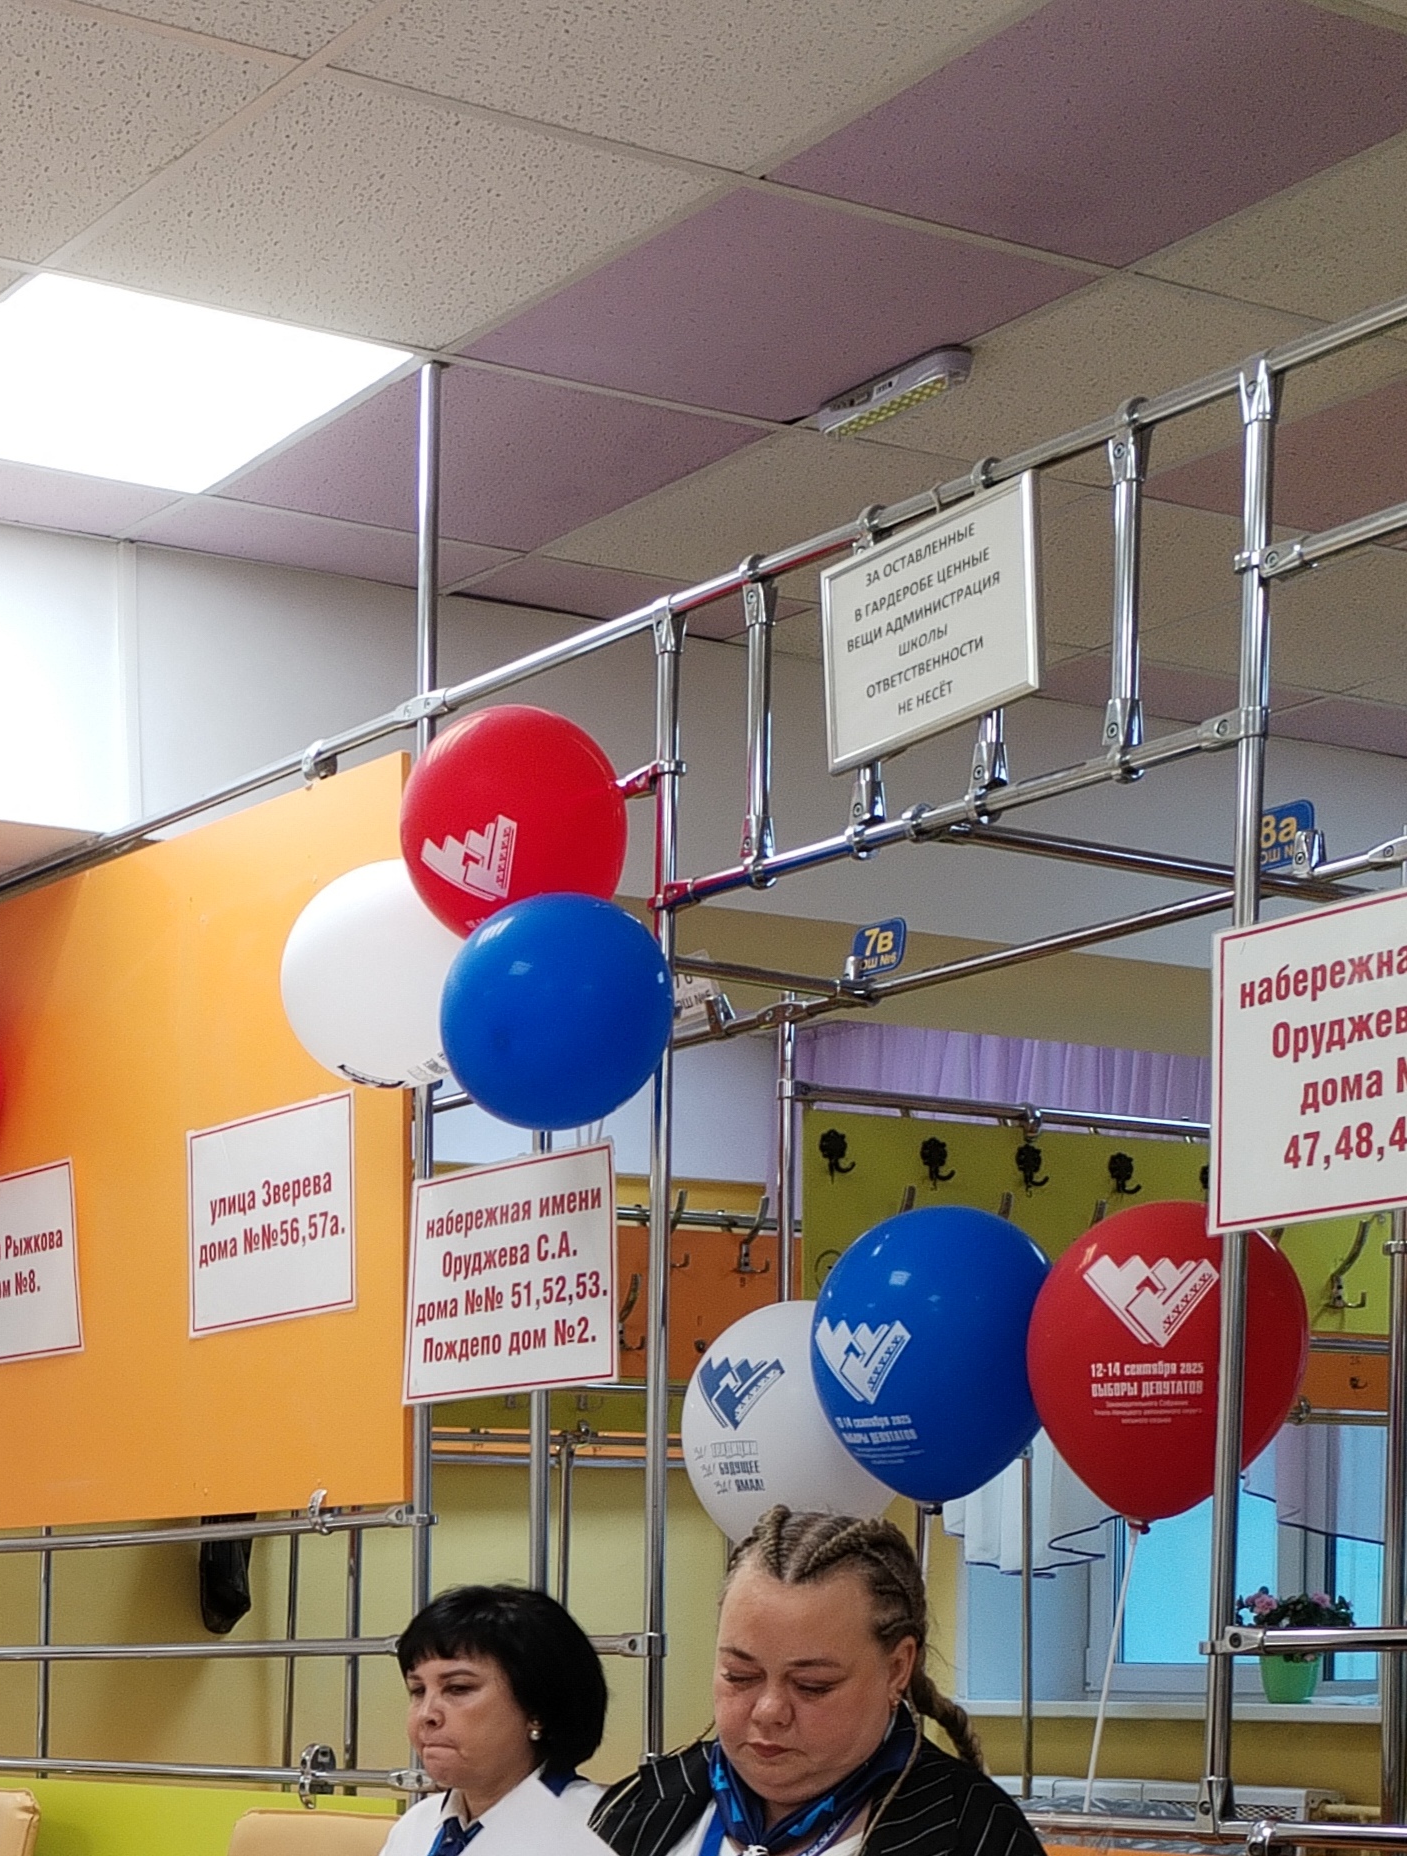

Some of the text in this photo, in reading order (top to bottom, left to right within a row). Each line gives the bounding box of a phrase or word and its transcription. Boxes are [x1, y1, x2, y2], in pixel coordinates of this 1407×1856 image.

[865, 522, 975, 587] ЗА ОСТАВЛЕННЫЕ
[855, 547, 990, 622] В ГАРДЕРОБЕ ЦЕННЫЕ
[847, 571, 1001, 652] ВЕЩИ АДМИНИСТРАЦИЯ
[898, 623, 948, 657] ШКОЛЫ
[866, 636, 983, 698] ОТВЕТСТВЕННОСТИ
[898, 680, 953, 716] НЕ НЕСЁТ
[1240, 944, 1407, 1009] набережна
[1272, 1005, 1407, 1063] Оруджев
[1300, 1069, 1383, 1116] дома
[1284, 1116, 1407, 1170] 47,48,4
[210, 1171, 332, 1225] улица Зверева
[426, 1187, 602, 1240] набережная имени
[5, 1228, 63, 1258] Рыжкова
[199, 1211, 345, 1268] дома №№56,57а.
[442, 1231, 578, 1281] Оруджева С.А.
[15, 1269, 41, 1296] №8.
[416, 1270, 608, 1327] дома №№ 51,52,53.
[423, 1316, 597, 1363] Пождепо дом №2.
[1091, 1361, 1204, 1378] 12-14 сентября 2025
[1091, 1380, 1204, 1398] ВЫБОРЫ ДЕПУТАТОВ
